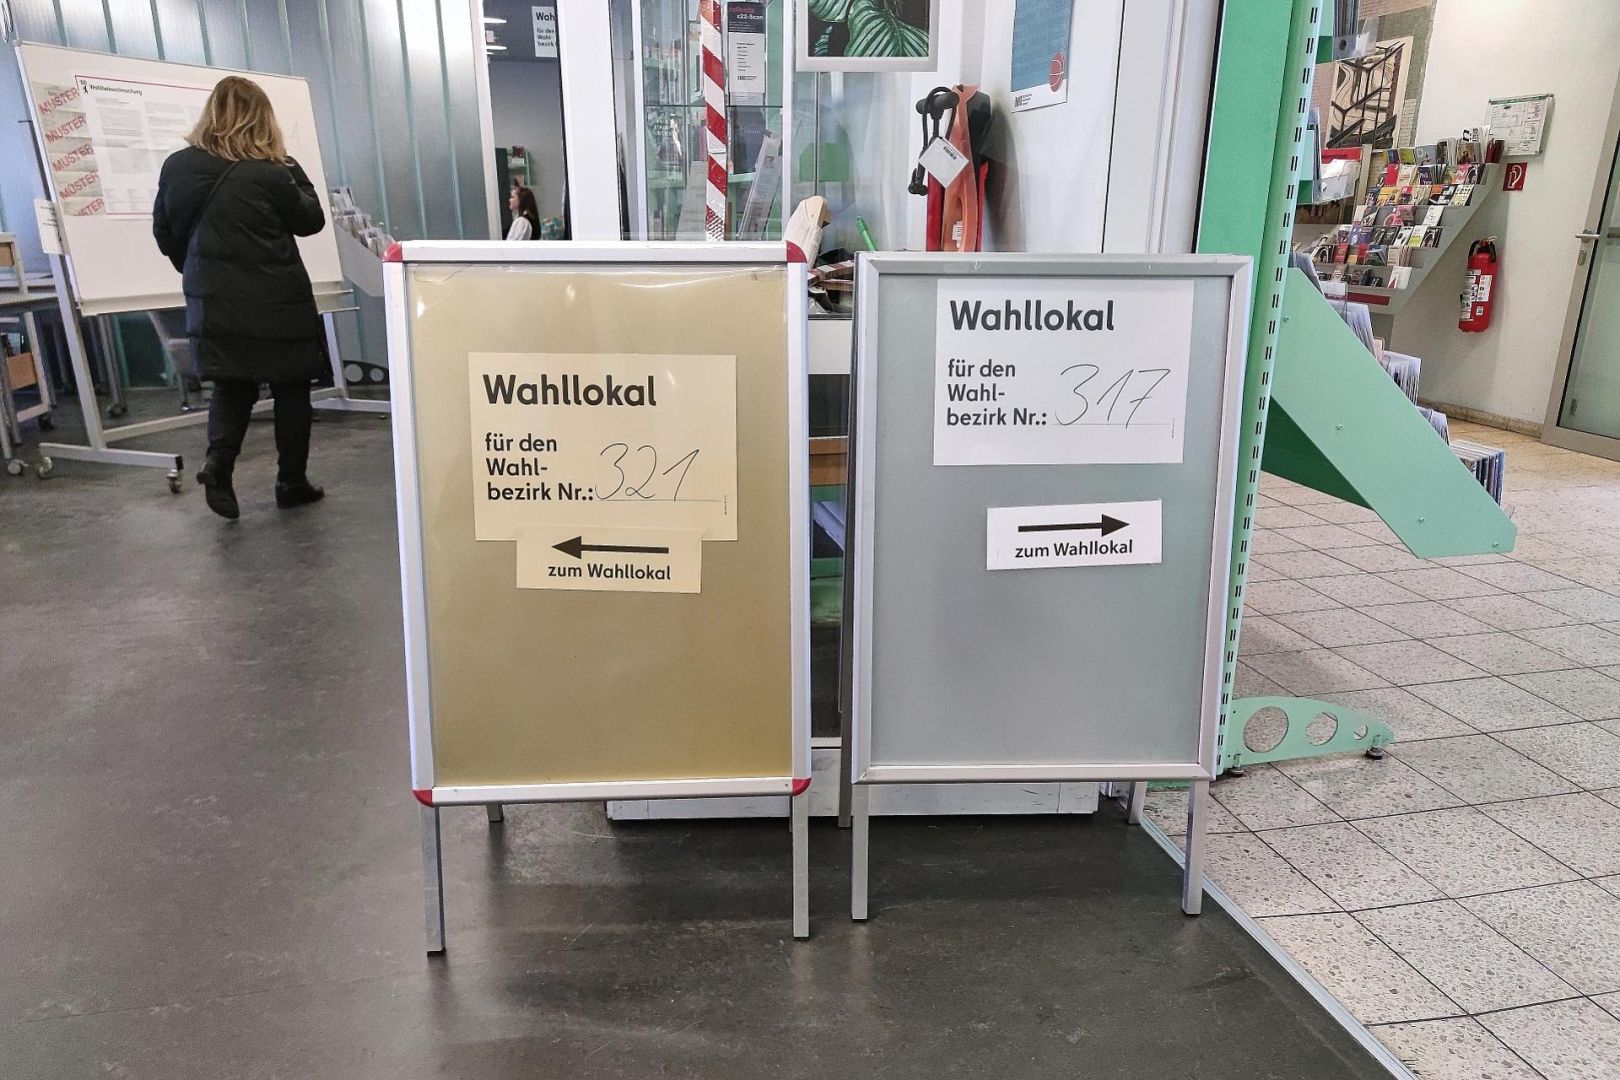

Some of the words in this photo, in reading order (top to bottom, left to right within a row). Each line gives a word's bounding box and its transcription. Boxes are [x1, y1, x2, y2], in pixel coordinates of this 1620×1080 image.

[38, 87, 80, 115] MUSTER
[45, 115, 87, 143] MUSTER
[52, 143, 95, 172] MUSTER
[59, 171, 100, 200] MUSTER
[74, 198, 105, 216] STER
[949, 299, 1115, 332] Wahllokal
[947, 358, 975, 378] für
[979, 358, 1016, 378] den
[482, 373, 657, 407] Wahllokal
[947, 383, 1006, 402] Wahl-
[1055, 363, 1171, 430] 317
[946, 407, 1007, 426] bezirk
[1013, 407, 1048, 426] Nr.:
[485, 432, 514, 452] für
[518, 432, 558, 452] den
[485, 457, 548, 477] Wahl-
[595, 443, 700, 502] 321
[487, 482, 552, 501] bezirk
[557, 482, 594, 502] Nr.:
[1014, 546, 1050, 559] zum
[1053, 539, 1133, 557] Wahllokal
[547, 565, 583, 578] zum
[586, 563, 671, 580] Wahllokal
